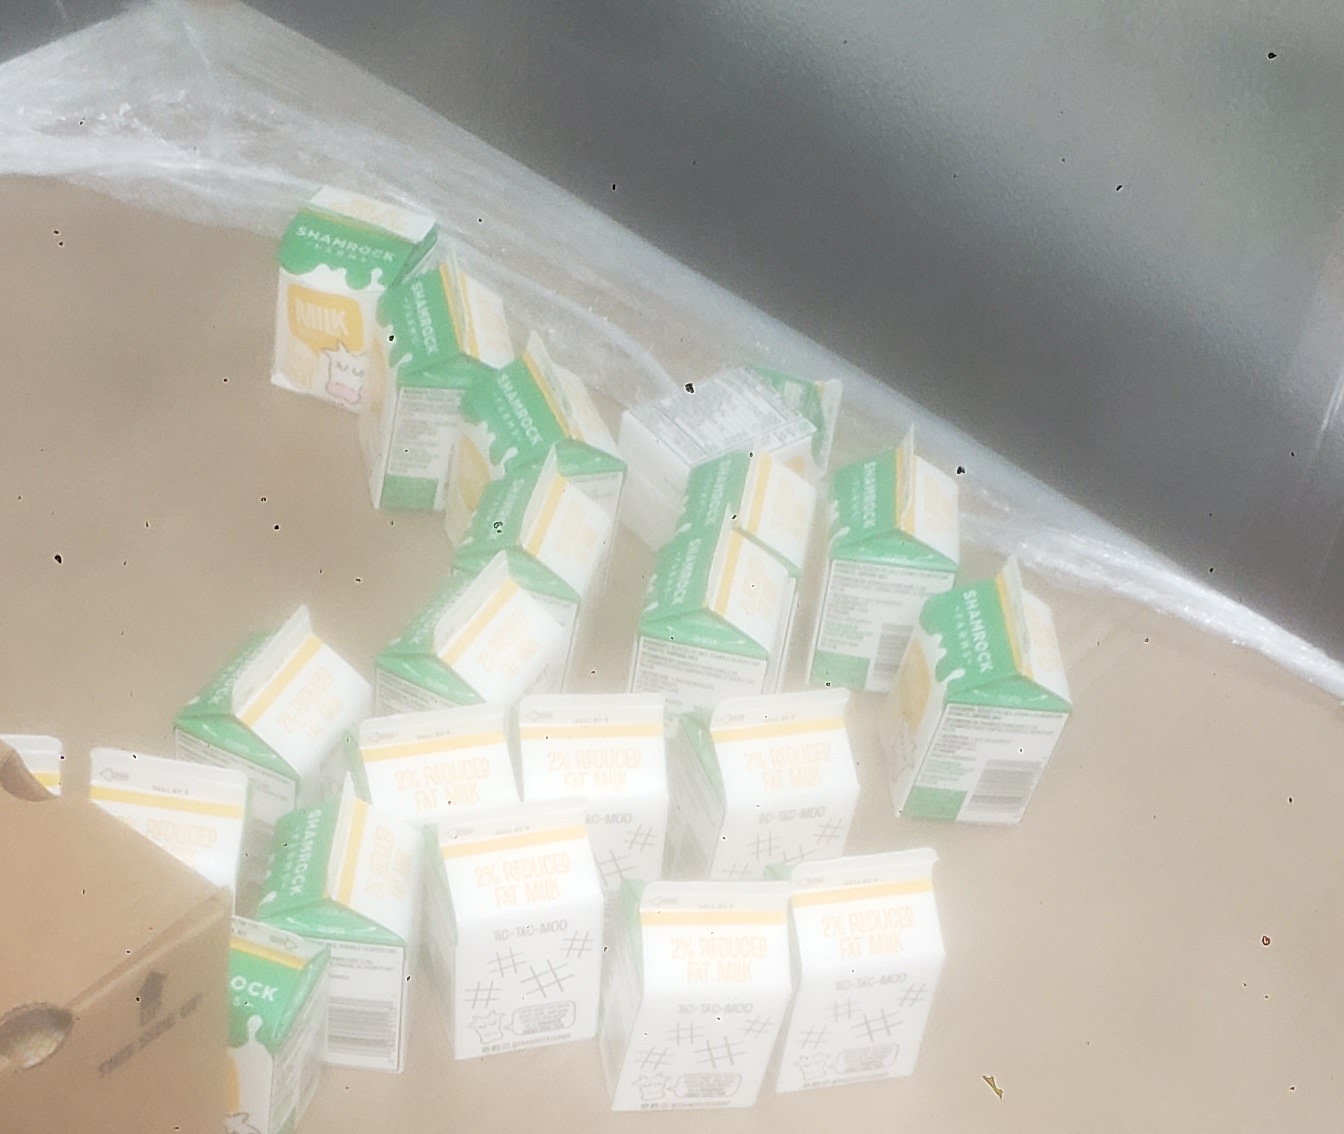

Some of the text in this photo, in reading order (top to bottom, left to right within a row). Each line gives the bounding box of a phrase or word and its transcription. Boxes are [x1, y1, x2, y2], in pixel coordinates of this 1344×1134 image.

[296, 226, 396, 263] SHAMROCK
[411, 280, 438, 354] SHAMROCK
[497, 374, 543, 446] SHAMROCK
[963, 589, 993, 675] SHAMROCK
[394, 757, 490, 790] 2% REDUCED
[547, 748, 642, 771] 2% REDUCED
[584, 812, 633, 825] AC-MOO
[289, 809, 322, 897] SHAMROCK
[474, 852, 570, 888] 2% REDUCED
[494, 878, 561, 907] FAT MILK
[492, 919, 568, 941] TIC-TAC-MOO
[820, 906, 914, 938] 2% REDUCED
[670, 936, 768, 960] 2% REDUCED
[839, 931, 904, 958] FAT MILK
[686, 960, 753, 983] FAT MILK
